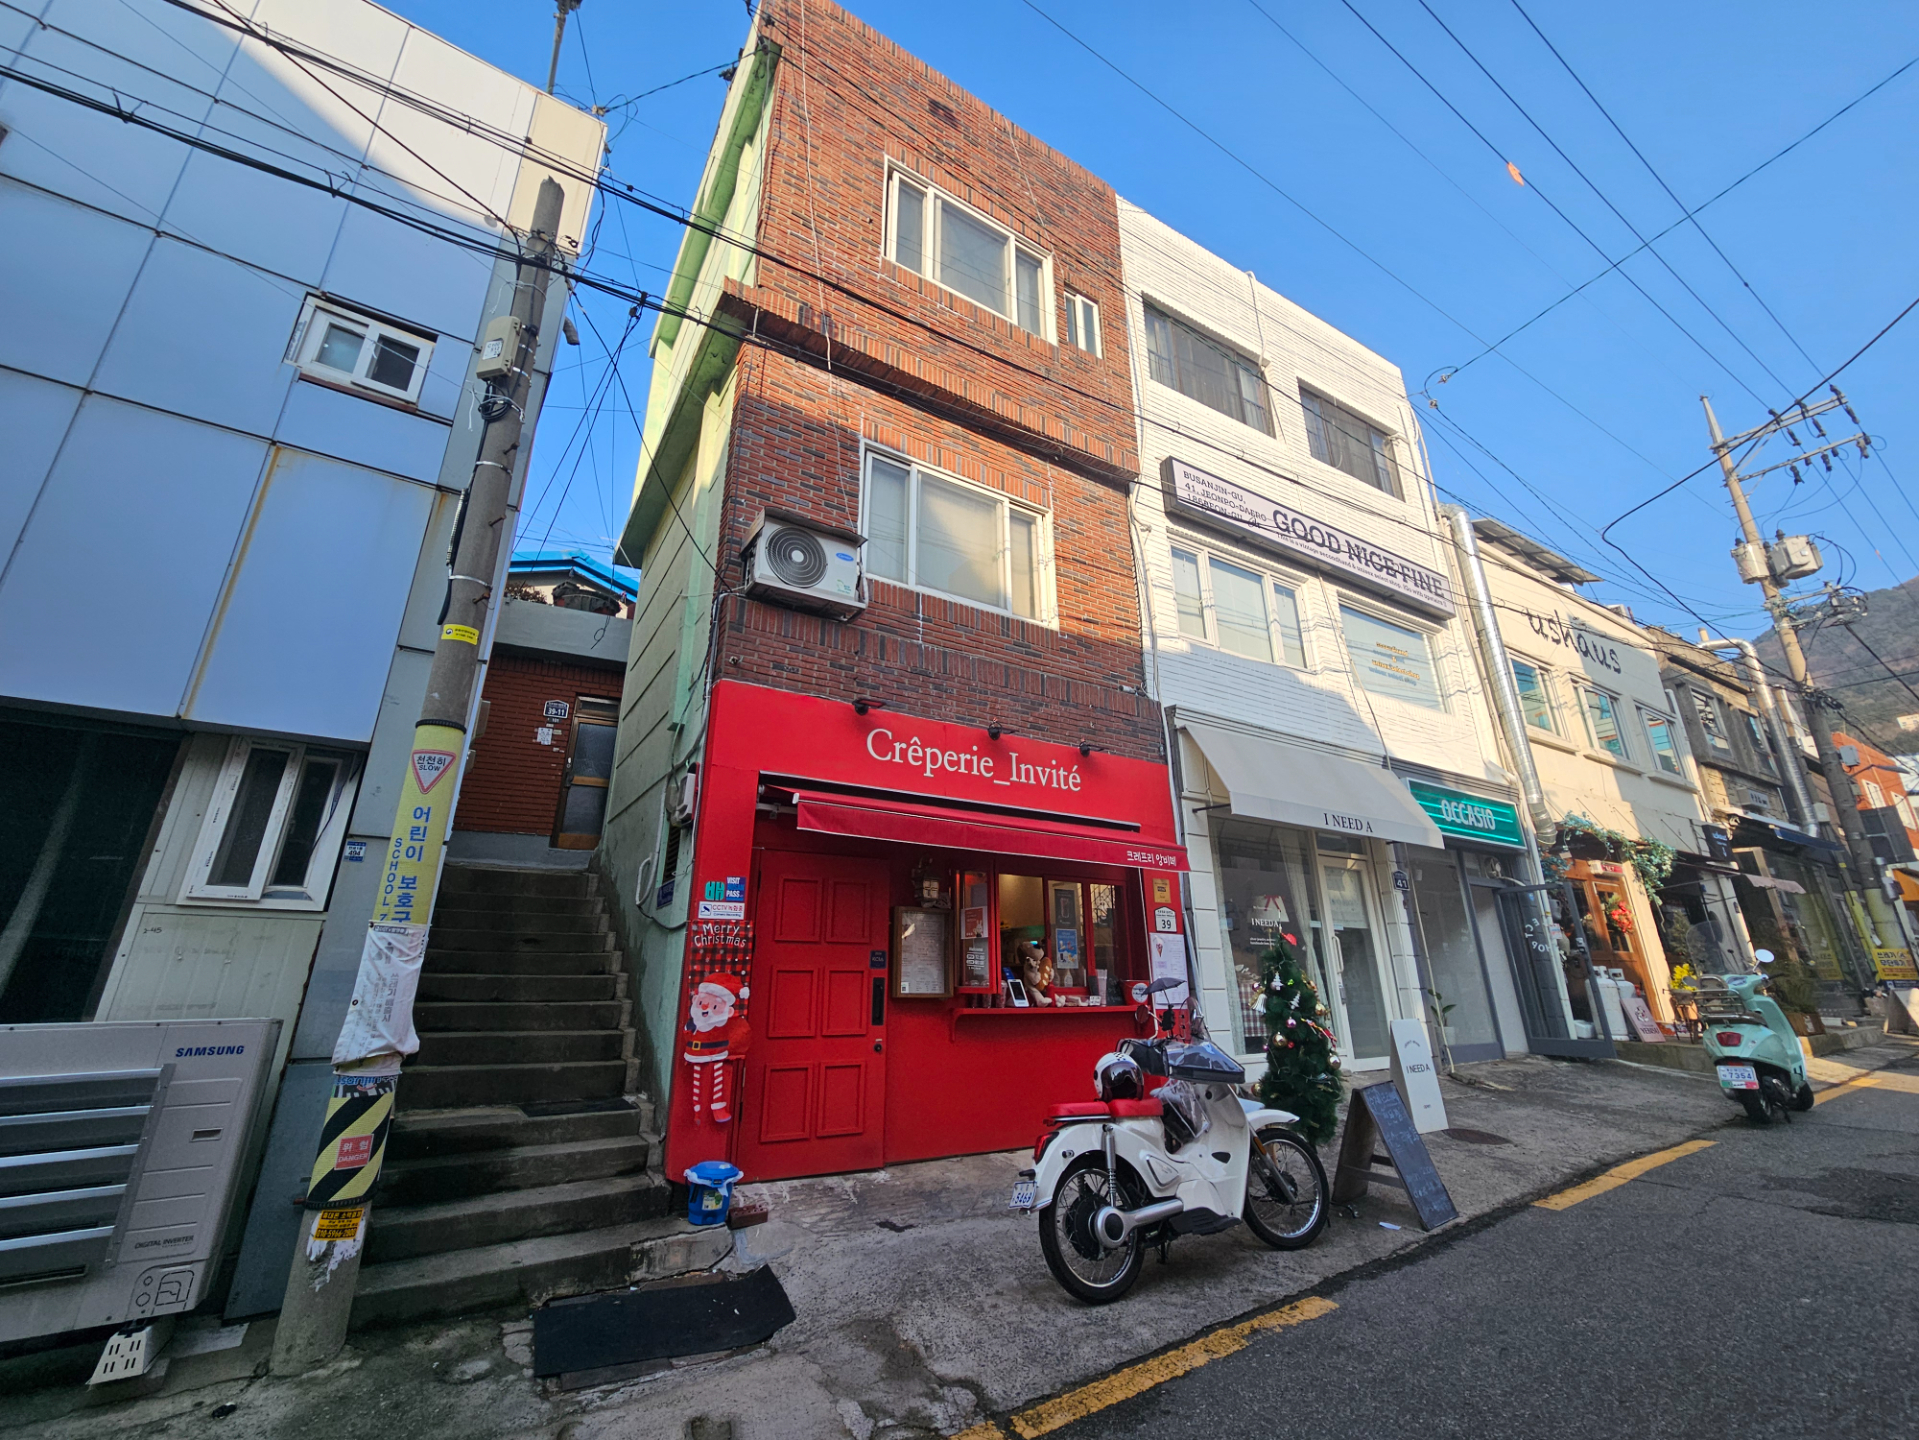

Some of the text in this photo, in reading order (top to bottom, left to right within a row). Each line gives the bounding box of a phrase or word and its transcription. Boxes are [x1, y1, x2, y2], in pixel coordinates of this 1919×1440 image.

[1183, 470, 1246, 504] BUSANJIN-GU,
[1200, 488, 1267, 522] JEONPO-DAERO
[1273, 509, 1445, 597] GOOD NICE FINE
[1300, 542, 1319, 556] vintage
[1320, 549, 1351, 568] secondhand
[547, 707, 565, 717] 39-11
[417, 755, 446, 766] 천천히
[866, 728, 1082, 792] Crêperie_Invité
[418, 764, 441, 772] SLOW
[1440, 799, 1496, 831] OCCASIO
[1323, 812, 1374, 834] I NEED A
[405, 806, 432, 862] 어린이
[1126, 851, 1155, 864] 크레프리
[382, 837, 403, 907] SCHOOL
[726, 876, 741, 885] VISIT
[1397, 879, 1409, 888] 41
[726, 890, 740, 898] PASS
[702, 922, 740, 937] Merry
[1161, 919, 1172, 930] 39
[1255, 918, 1275, 927] NEED
[694, 933, 747, 948] Christmas
[175, 1044, 245, 1058] SAMSUNG
[1409, 1065, 1426, 1074] NEED
[1728, 1072, 1753, 1080] 7354
[337, 1153, 368, 1163] DANGER
[134, 1235, 194, 1249] DIGITAL INVERTER
